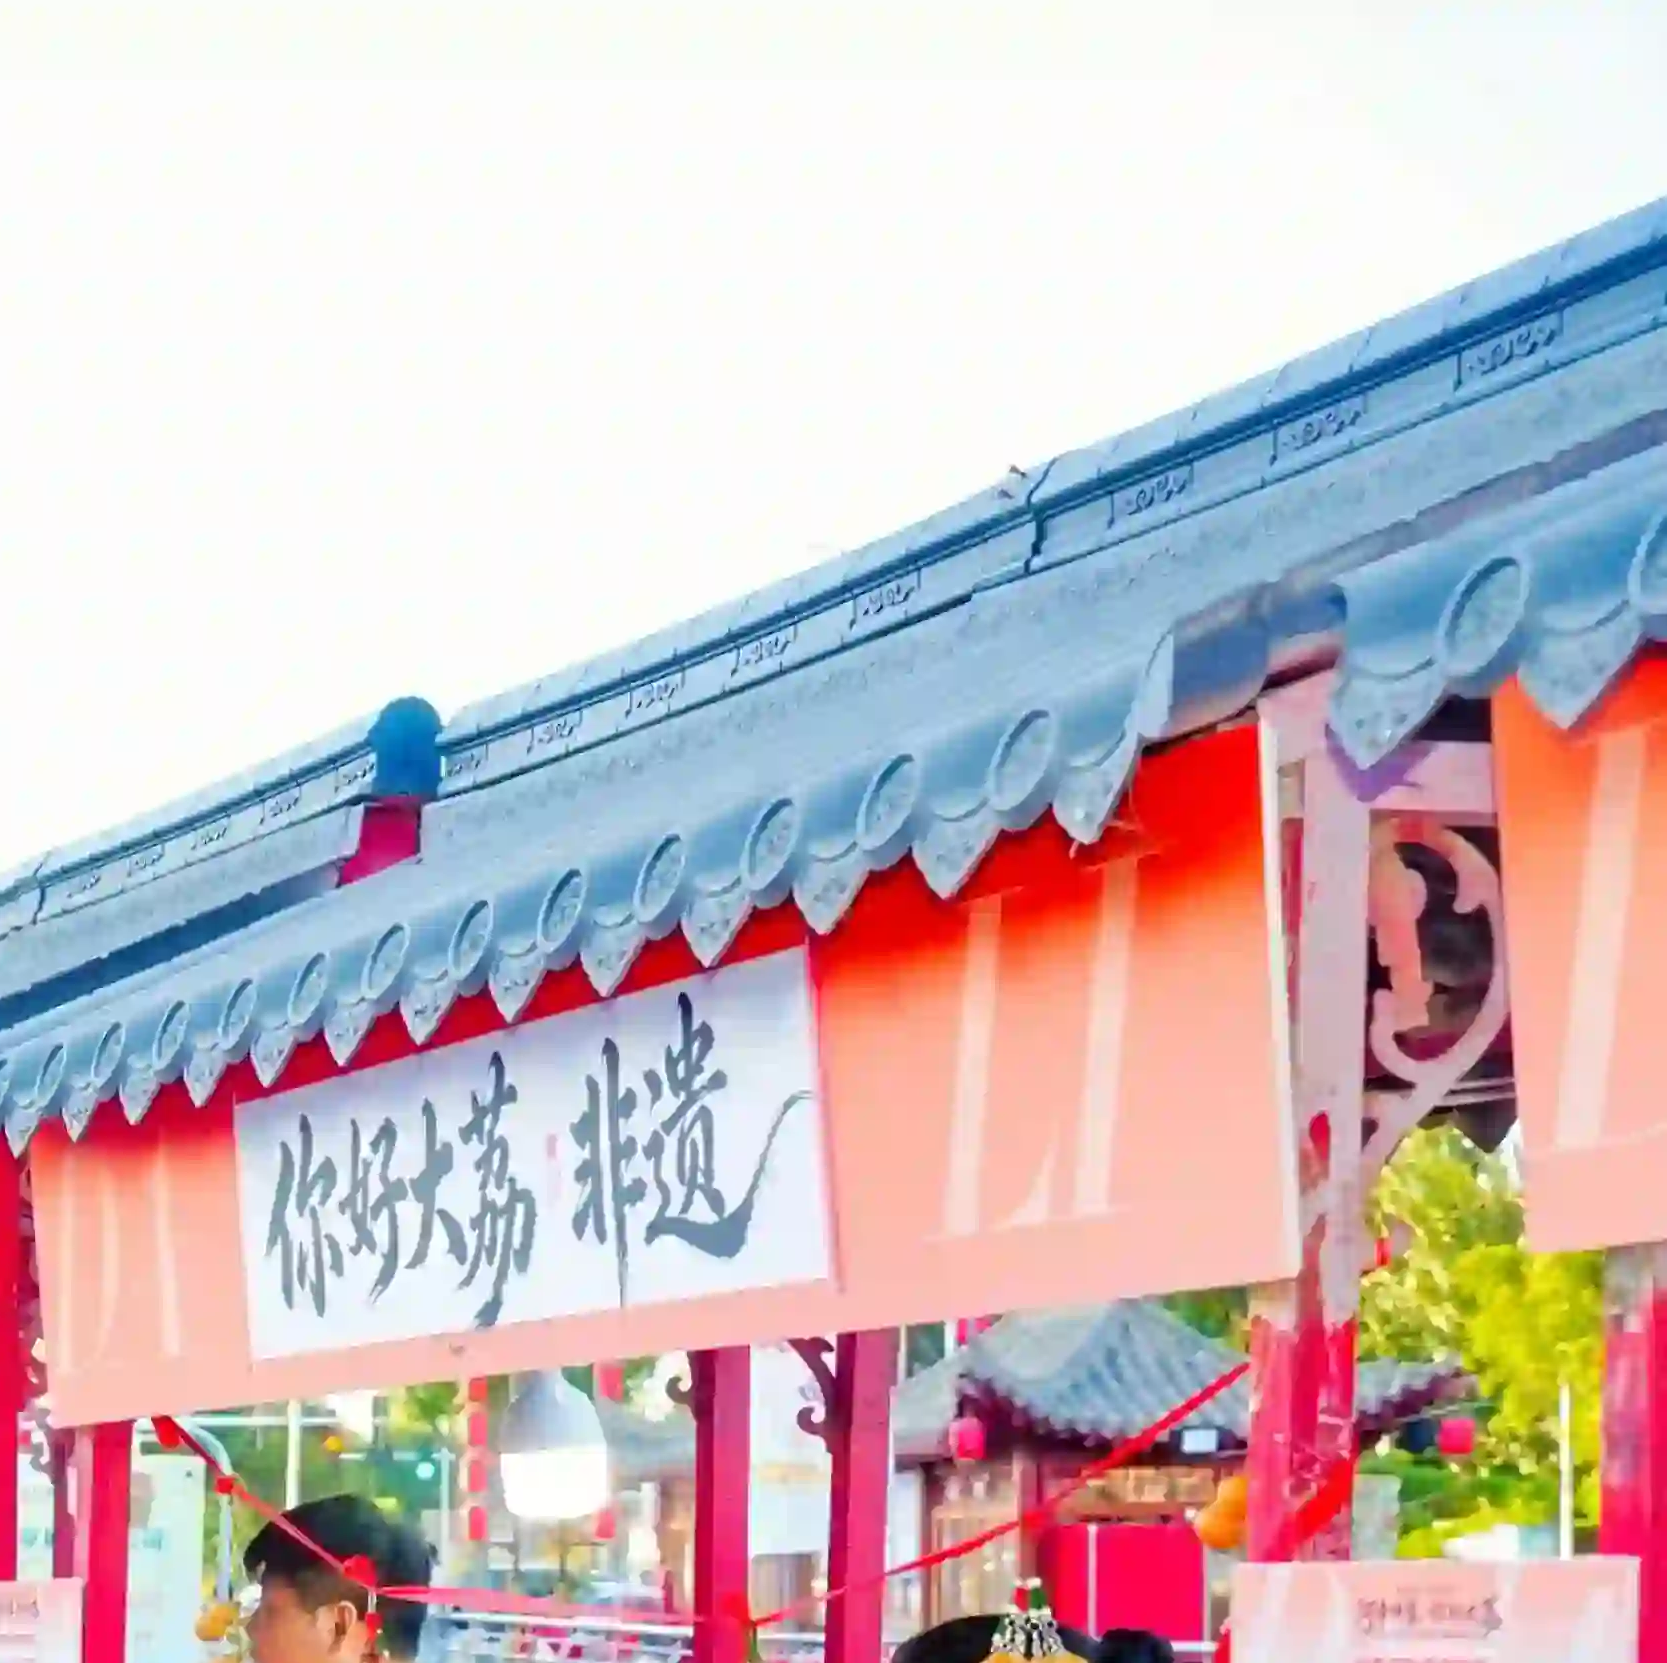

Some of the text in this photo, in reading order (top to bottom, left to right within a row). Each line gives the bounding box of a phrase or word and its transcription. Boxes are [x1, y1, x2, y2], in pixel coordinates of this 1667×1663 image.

[265, 1049, 537, 1328] 你好大荔
[569, 991, 813, 1308] 非遗
